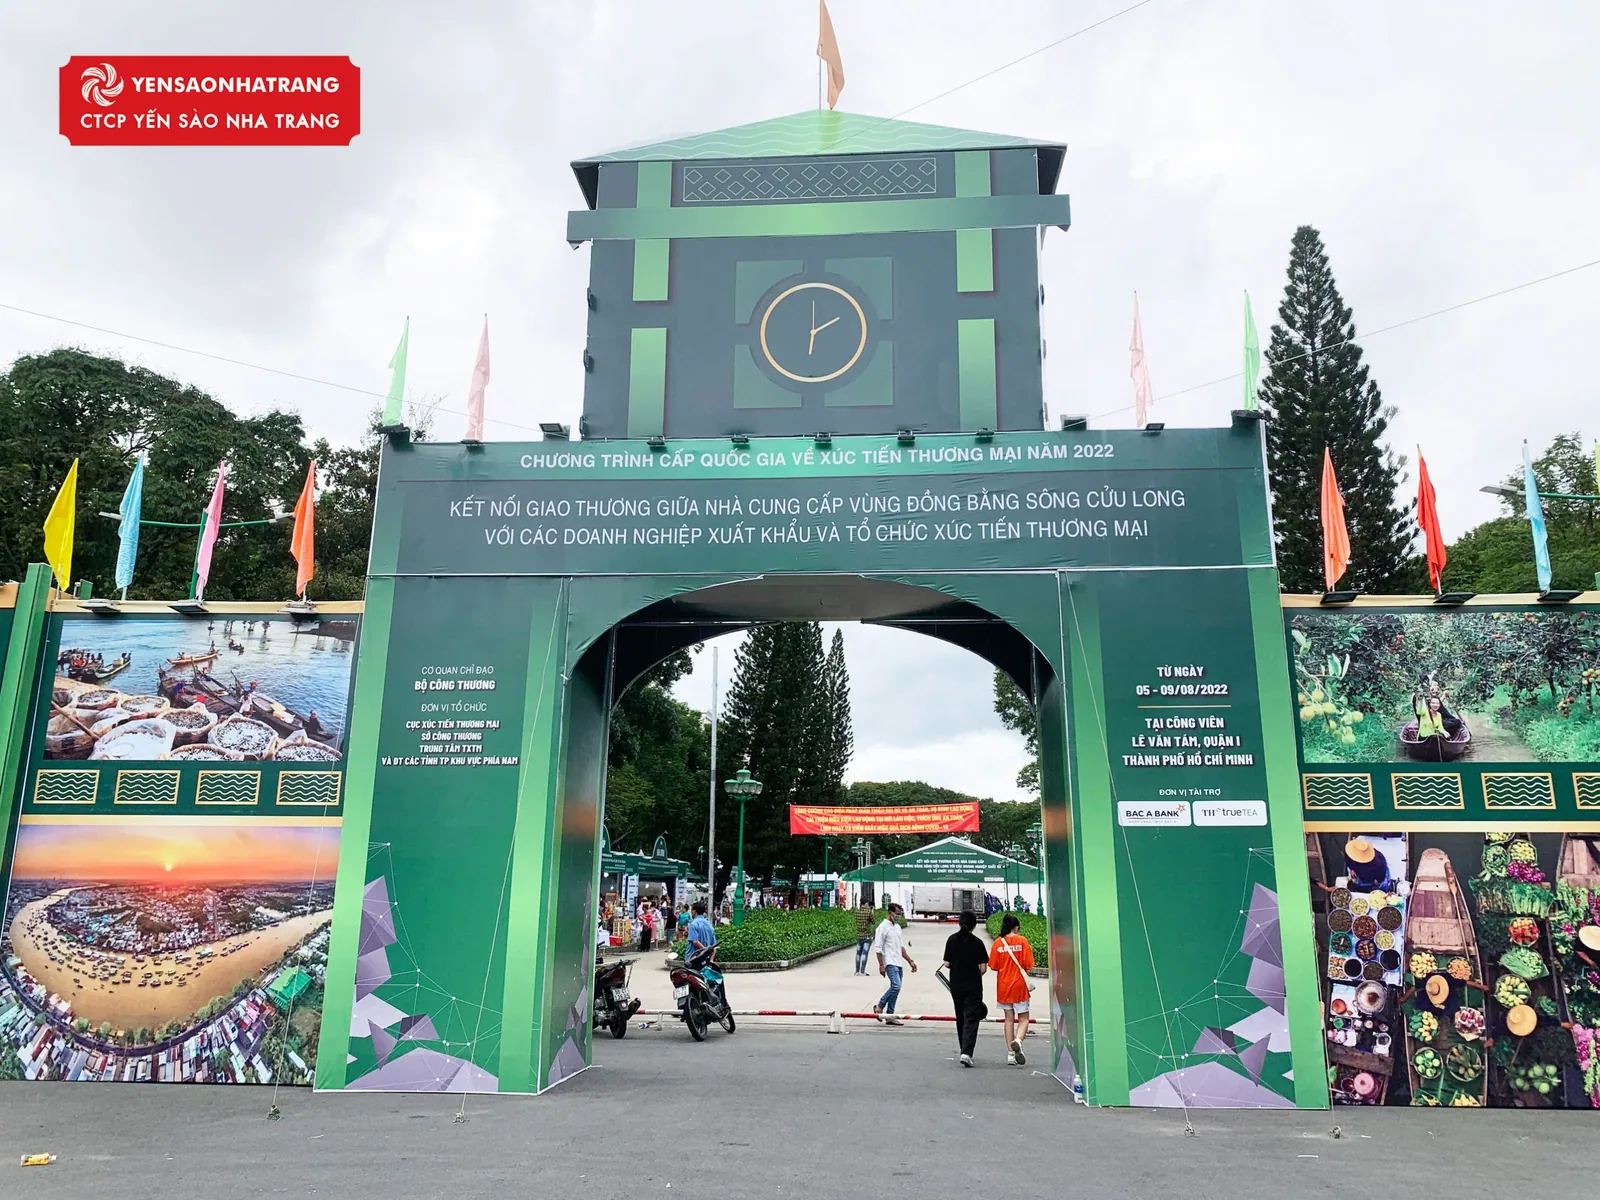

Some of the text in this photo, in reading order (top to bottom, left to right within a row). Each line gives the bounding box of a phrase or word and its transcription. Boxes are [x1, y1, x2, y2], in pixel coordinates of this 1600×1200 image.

[520, 442, 1115, 469] CHƯƠNG TRÌNH CẤP QUỐC GIA VỀ XÚC TIẾN THƯƠNG MẠI NĂM 2022
[450, 484, 1186, 518] KẾT NỐI GIAO THƯƠNG GIỮA NHÀ CUNG CẤP VÙNG ĐỒNG BẰNG SÔNG CỬU LONG
[485, 515, 1149, 548] VỚI CÁC DOANH NGHIỆP XUẤT KHẨU VÀ TỔ CHỨC XÚC TIẾN THƯƠNG MẠI
[421, 664, 494, 676] CƠ QUAN CHỈ ĐẠO
[1157, 664, 1204, 678] TỪ NGÀY
[414, 679, 496, 693] BỘ CÔNG THƯƠNG
[1136, 685, 1150, 696] 05
[1160, 684, 1228, 695] 09/08/2022
[421, 700, 488, 713] ĐƠN VỊ TỔ CHỨC
[406, 718, 500, 731] CỤC XÚC TIẾN THƯƠNG MẠI
[1145, 715, 1224, 732] TẠI CÔNG VIÊN
[421, 731, 483, 741] SỞ CÔNG THƯƠNG
[1131, 734, 1146, 747] LÊ
[1148, 735, 1172, 747] VĂN
[1173, 734, 1201, 749] TÁM,
[1203, 734, 1234, 749] QUẬN
[419, 744, 444, 753] TRUNG
[445, 743, 461, 753] TÂM
[1122, 751, 1253, 766] THÀNH PHỐ HỒ CHÍ MINH
[1178, 789, 1187, 797] VỊ
[1189, 788, 1202, 796] TÀI
[1204, 788, 1222, 797] TRỢ
[1125, 810, 1145, 818] BAC
